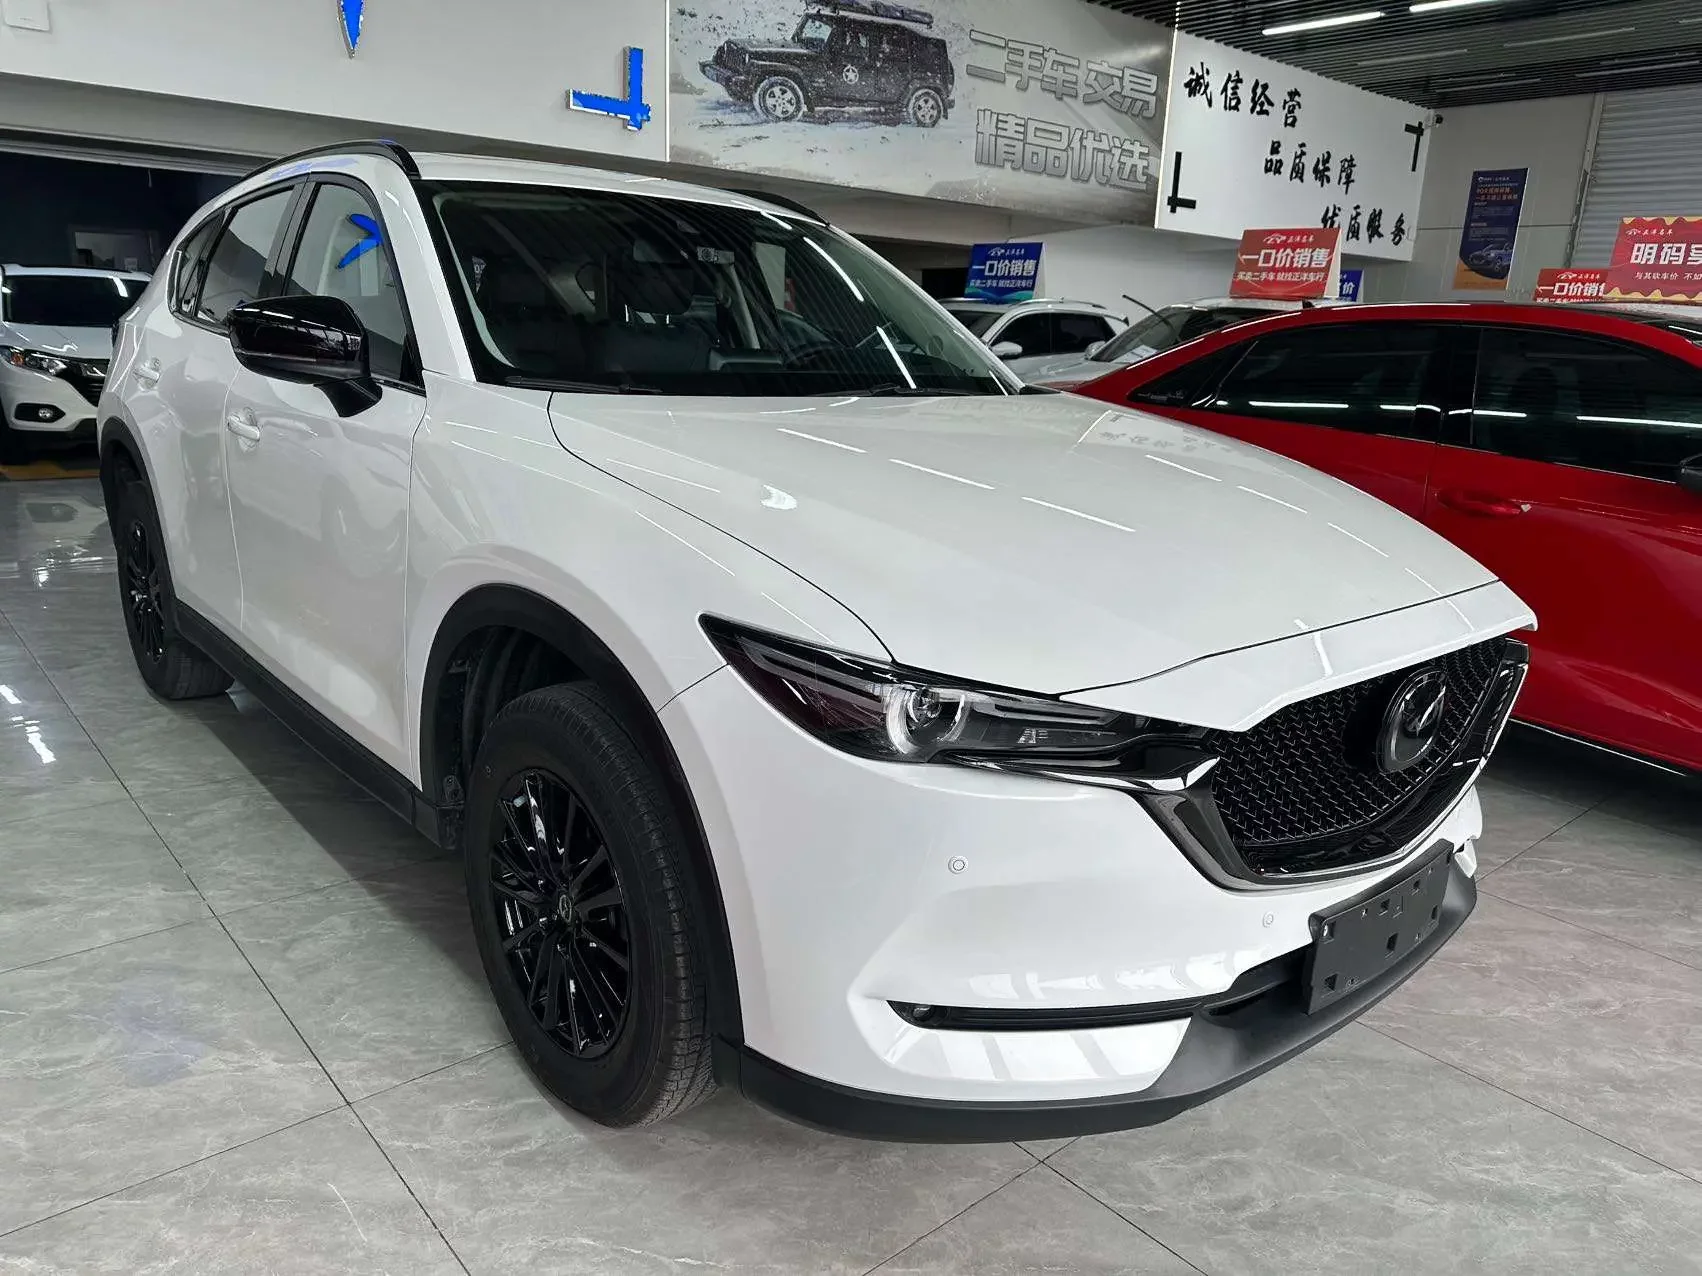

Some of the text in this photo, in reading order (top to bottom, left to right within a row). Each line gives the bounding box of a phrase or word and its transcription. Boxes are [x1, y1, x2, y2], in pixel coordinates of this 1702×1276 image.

[966, 29, 1158, 118] 二手车交易
[1184, 62, 1302, 128] 诚信经营
[975, 109, 1149, 192] 精品优选
[1264, 140, 1357, 195] 品质保障
[1321, 204, 1406, 246] 优质服务
[971, 259, 1036, 276] 一口价销售
[1242, 247, 1330, 268] 一口价销售
